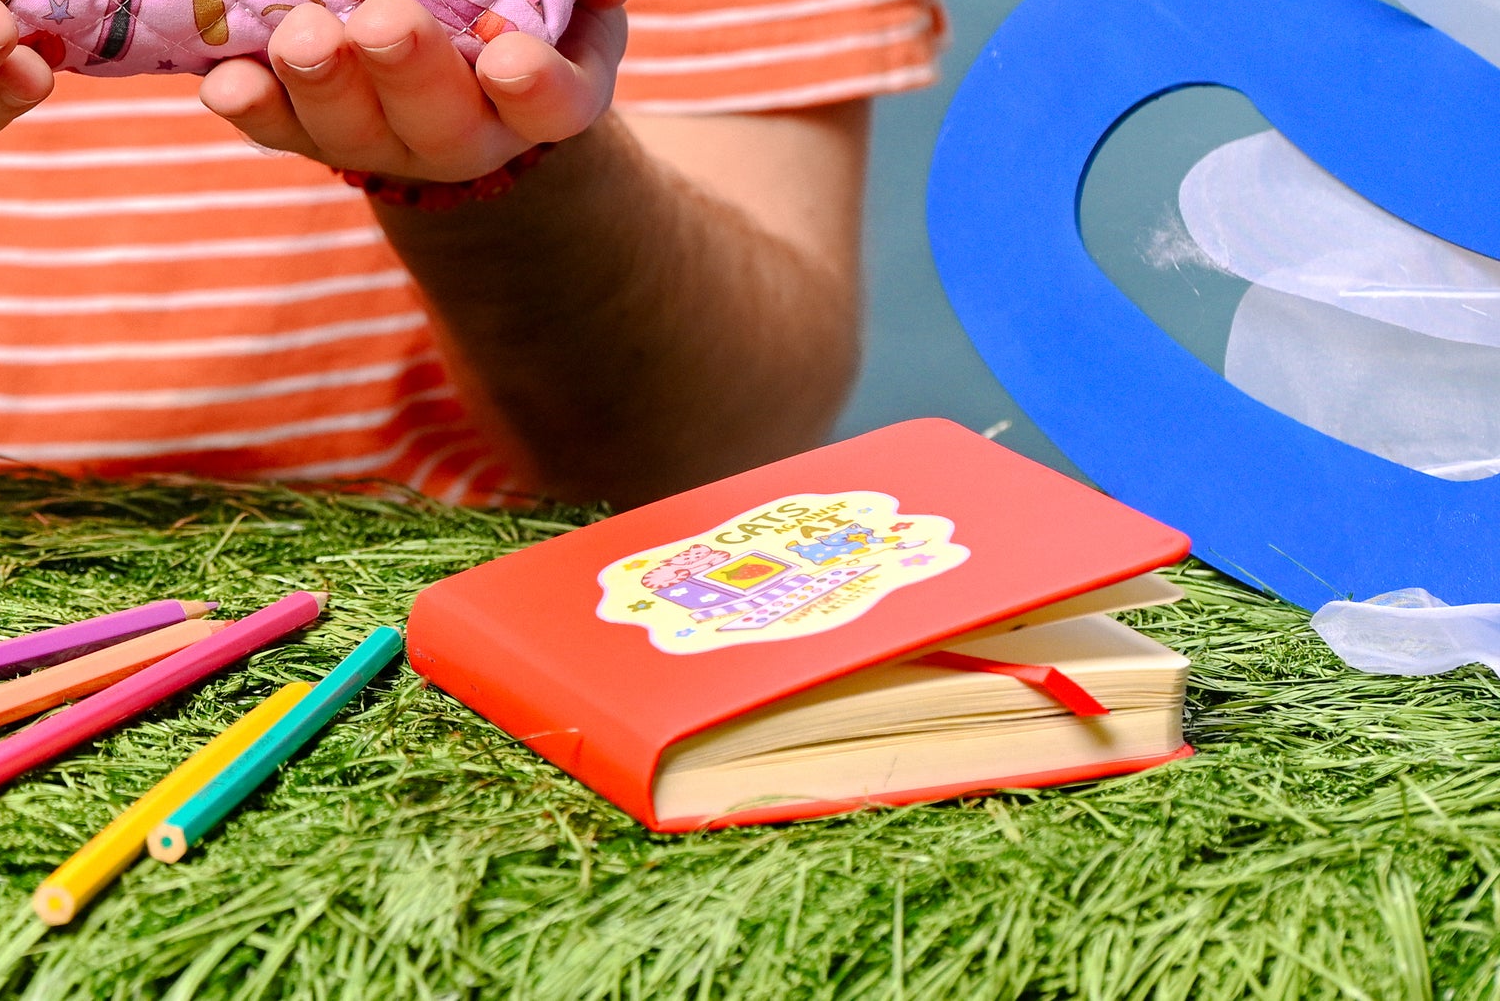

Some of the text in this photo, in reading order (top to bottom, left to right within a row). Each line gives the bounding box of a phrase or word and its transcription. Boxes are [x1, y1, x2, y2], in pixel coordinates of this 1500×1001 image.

[714, 502, 811, 544] CATS
[773, 501, 847, 534] AGAINST
[800, 513, 854, 539] AI
[820, 586, 877, 615] ARTISTS
